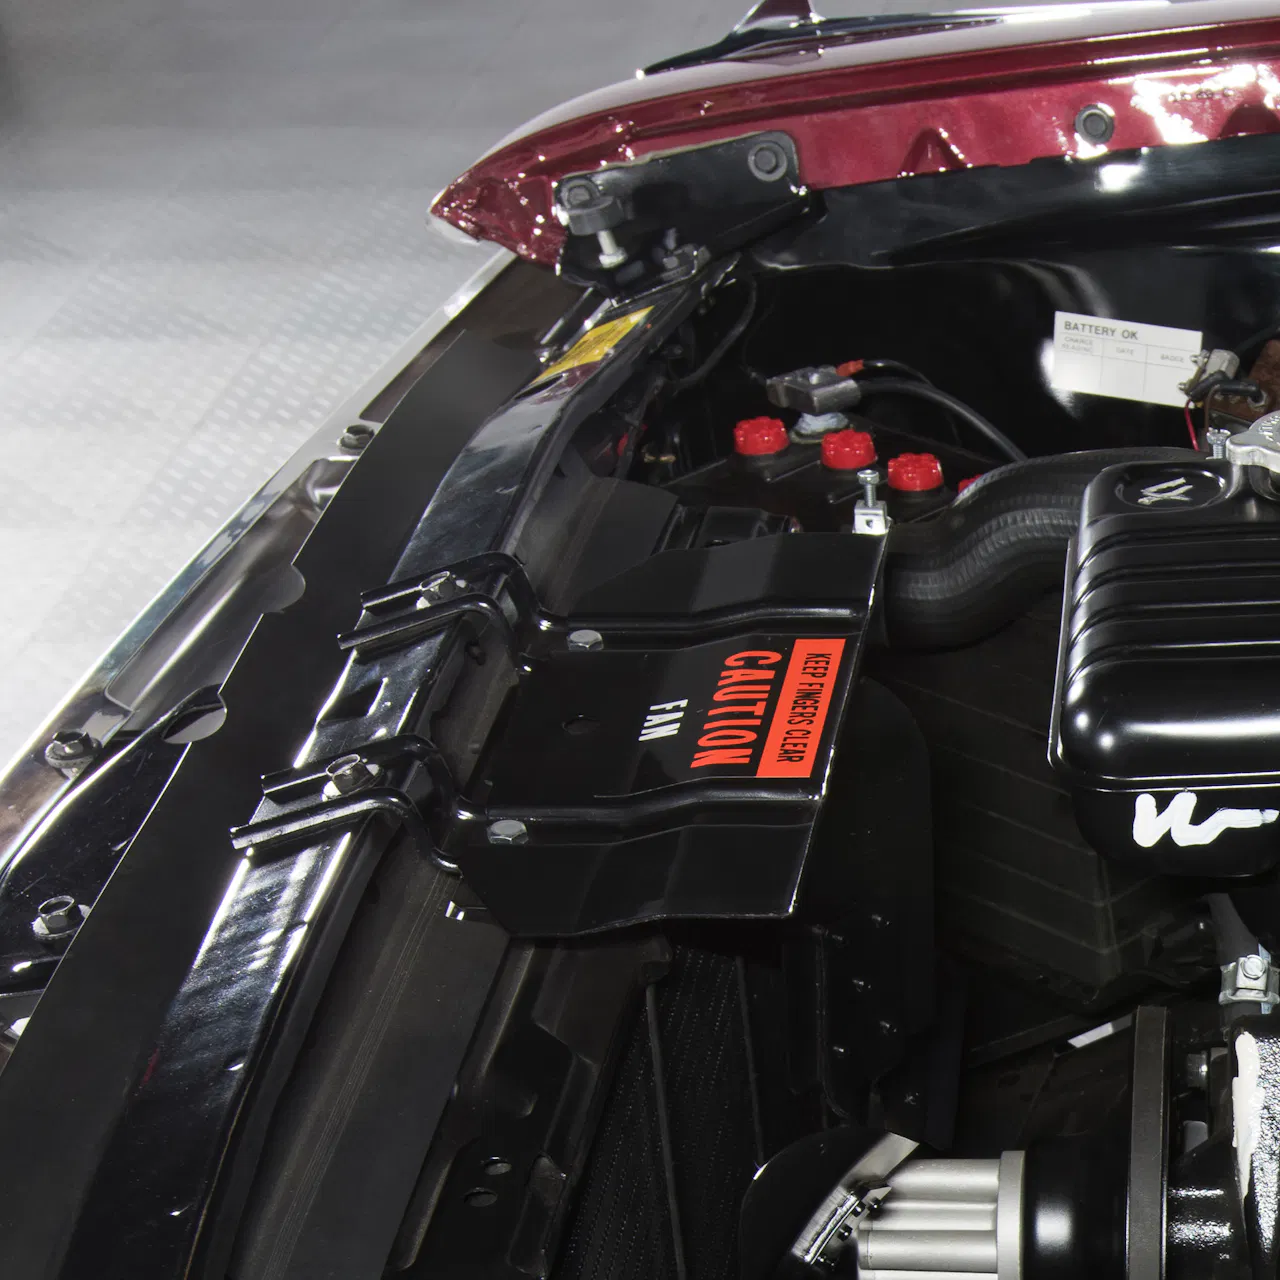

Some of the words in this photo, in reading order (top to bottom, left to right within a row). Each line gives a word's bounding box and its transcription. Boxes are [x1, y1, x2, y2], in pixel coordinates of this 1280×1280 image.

[1064, 320, 1117, 337] BATTERY
[1121, 329, 1138, 340] OK
[801, 652, 832, 678] KEEP
[638, 699, 688, 741] FAN
[690, 650, 783, 768] CAUTION
[786, 681, 824, 726] FINGERS
[776, 728, 811, 764] CLEAR
